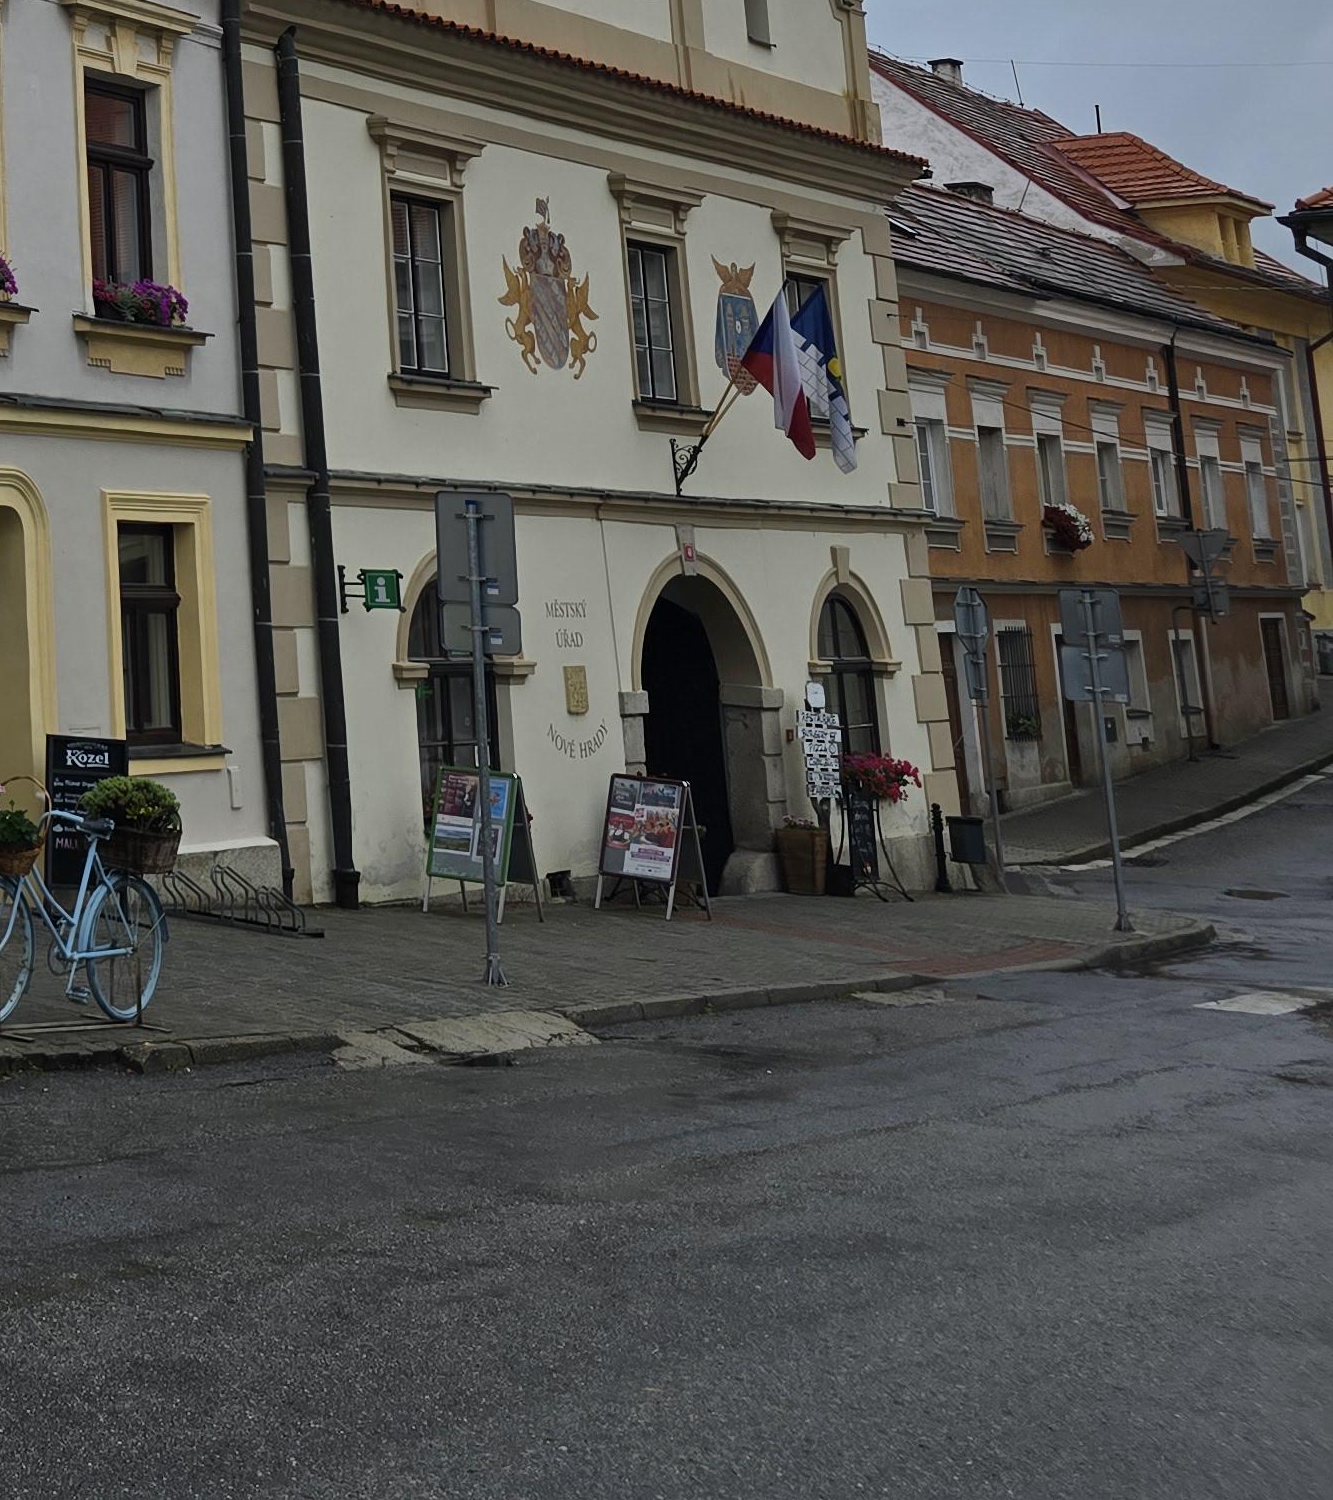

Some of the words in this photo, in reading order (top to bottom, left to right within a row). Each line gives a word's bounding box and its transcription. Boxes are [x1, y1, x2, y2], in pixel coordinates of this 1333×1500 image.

[545, 599, 587, 619] MĚSTSKÝ
[555, 629, 584, 648] ÚŘAD
[547, 722, 576, 759] NOVÉ
[65, 749, 110, 768] Kozel
